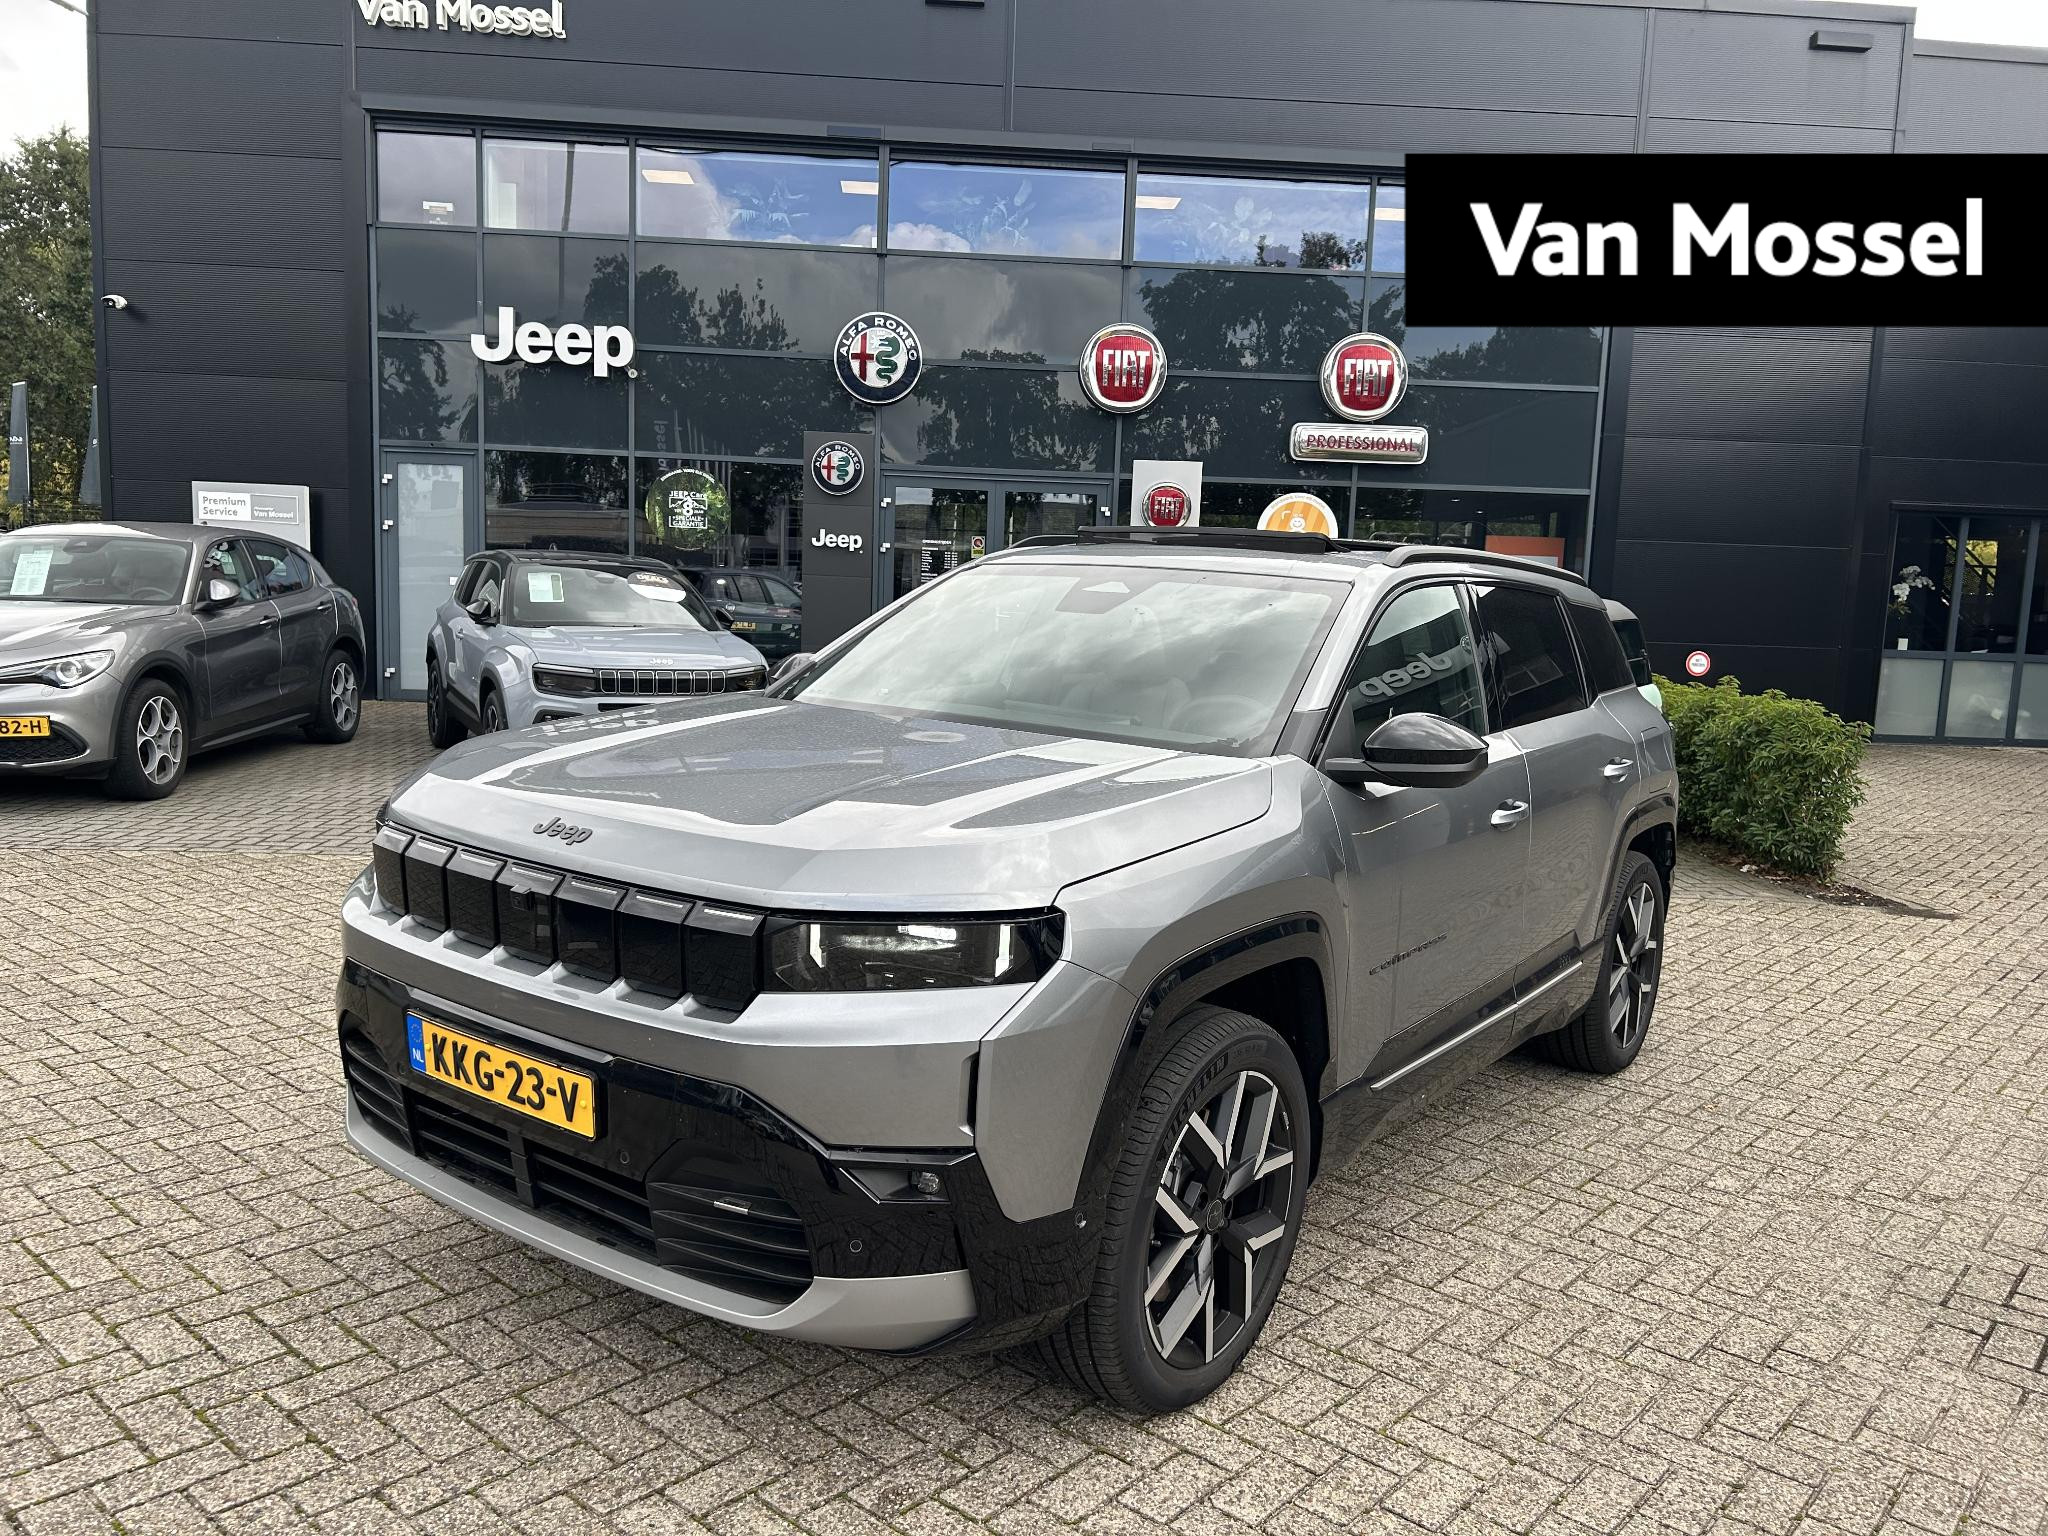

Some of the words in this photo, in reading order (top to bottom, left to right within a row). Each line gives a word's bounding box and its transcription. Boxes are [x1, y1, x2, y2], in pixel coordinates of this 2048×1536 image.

[358, 0, 429, 29] Van
[436, 0, 566, 39] Mossel
[470, 306, 634, 378] Jeep
[840, 321, 868, 356] ALFA
[874, 317, 917, 361] ROMEO
[1102, 349, 1151, 388] FIAT
[1343, 358, 1392, 396] FIAT
[1306, 434, 1417, 452] PROFESSIONAL
[815, 447, 832, 467] ALFA
[834, 444, 861, 470] ROMEO
[202, 496, 246, 506] Premium
[669, 490, 688, 498] JEEP
[203, 507, 239, 516] Service
[268, 511, 294, 519] Mossel
[682, 501, 694, 516] 8
[1153, 496, 1183, 519] FIAT
[811, 528, 863, 551] Jeep
[0, 720, 42, 734] 82-H
[533, 816, 593, 845] Jeep
[412, 1047, 424, 1063] NL
[431, 1032, 579, 1122] KKG-23-V
